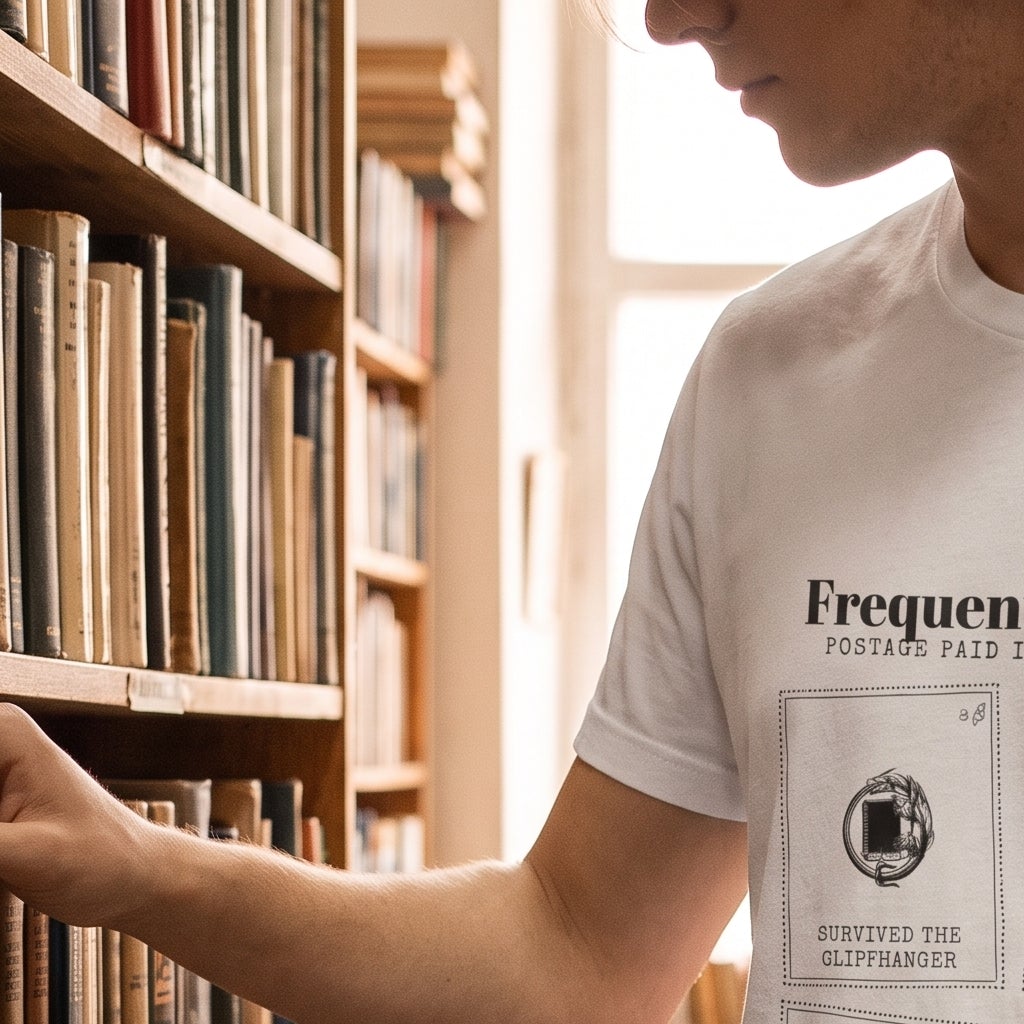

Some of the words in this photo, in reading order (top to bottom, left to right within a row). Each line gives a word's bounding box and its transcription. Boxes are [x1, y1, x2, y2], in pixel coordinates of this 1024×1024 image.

[825, 636, 928, 656] POSTAGE
[941, 640, 999, 659] PAID
[817, 925, 914, 943] SURVIVED
[921, 926, 961, 944] THE
[822, 950, 957, 968] GLIPFHANGER
